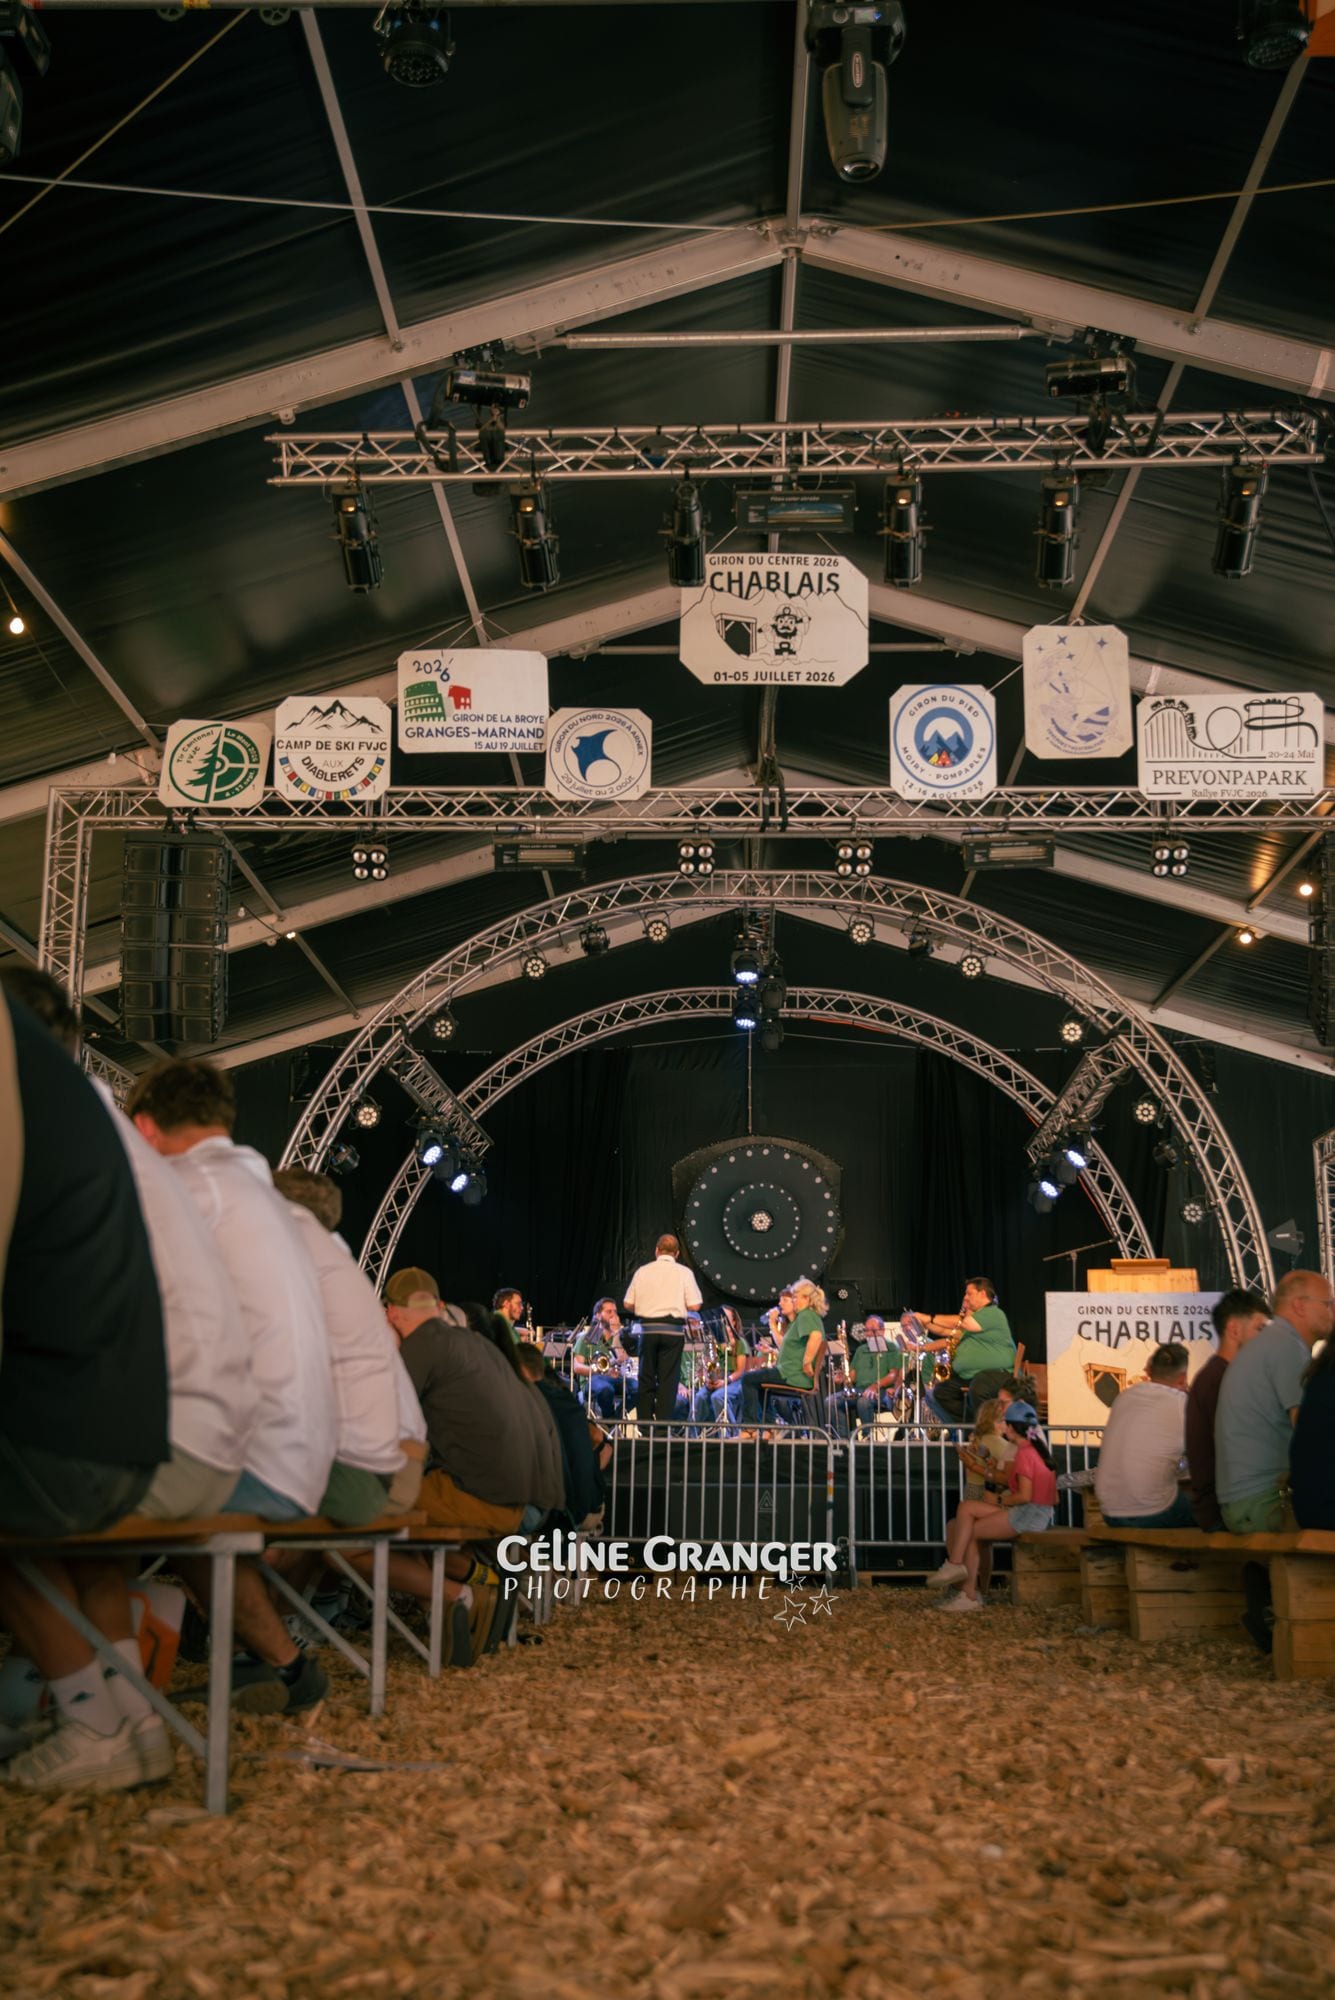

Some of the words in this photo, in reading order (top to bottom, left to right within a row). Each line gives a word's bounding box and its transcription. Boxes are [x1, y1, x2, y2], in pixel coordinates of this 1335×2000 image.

[709, 556, 744, 566] GIRON
[749, 556, 763, 566] DU
[767, 556, 810, 566] CENTRE
[813, 557, 840, 567] 2026
[710, 571, 840, 600] CHABLAIS
[412, 659, 451, 682] 2026
[713, 671, 749, 681] 01-05
[752, 672, 801, 682] JUILLET
[805, 672, 835, 682] 2026
[908, 695, 938, 717] GIRON
[941, 694, 956, 703] DU
[958, 699, 980, 718] PIED
[452, 714, 484, 722] GIRON
[486, 714, 498, 722] DE
[501, 714, 512, 723] LA
[515, 715, 545, 724] BROYE
[405, 727, 545, 739] GRANGES-MARNAND
[554, 728, 570, 753] GIRON
[567, 718, 580, 728] DU
[578, 713, 604, 724] NORD
[605, 714, 627, 727] 2026
[176, 753, 185, 764] Tir
[182, 728, 215, 753] Cantonal
[276, 740, 312, 750] CAMP
[315, 741, 332, 750] DE
[335, 741, 355, 751] SKI
[358, 741, 388, 751] FVJC
[485, 742, 497, 750] AU
[500, 742, 508, 750] 19
[509, 743, 545, 751] JUILLET
[1268, 751, 1295, 759] 20-24
[1297, 750, 1315, 759] Mai
[301, 755, 366, 782] DIABLERETS
[322, 759, 344, 768] AUX
[901, 746, 925, 773] MOIRY
[935, 747, 986, 781] POMPAPLES
[560, 772, 573, 785] 29
[568, 782, 593, 796] juillet
[594, 789, 607, 797] au
[609, 787, 615, 795] 2
[615, 775, 636, 792] août
[1152, 770, 1307, 785] PREVONPAPARK
[962, 780, 984, 796] 2026
[1191, 789, 1218, 799] Rallye
[1220, 789, 1244, 798] FVJC
[1077, 1306, 1113, 1315] GIRON
[1117, 1306, 1132, 1315] DU
[1136, 1306, 1179, 1315] CENTRE
[1183, 1306, 1211, 1315] 2026
[1077, 1321, 1213, 1350] CHABLAIS
